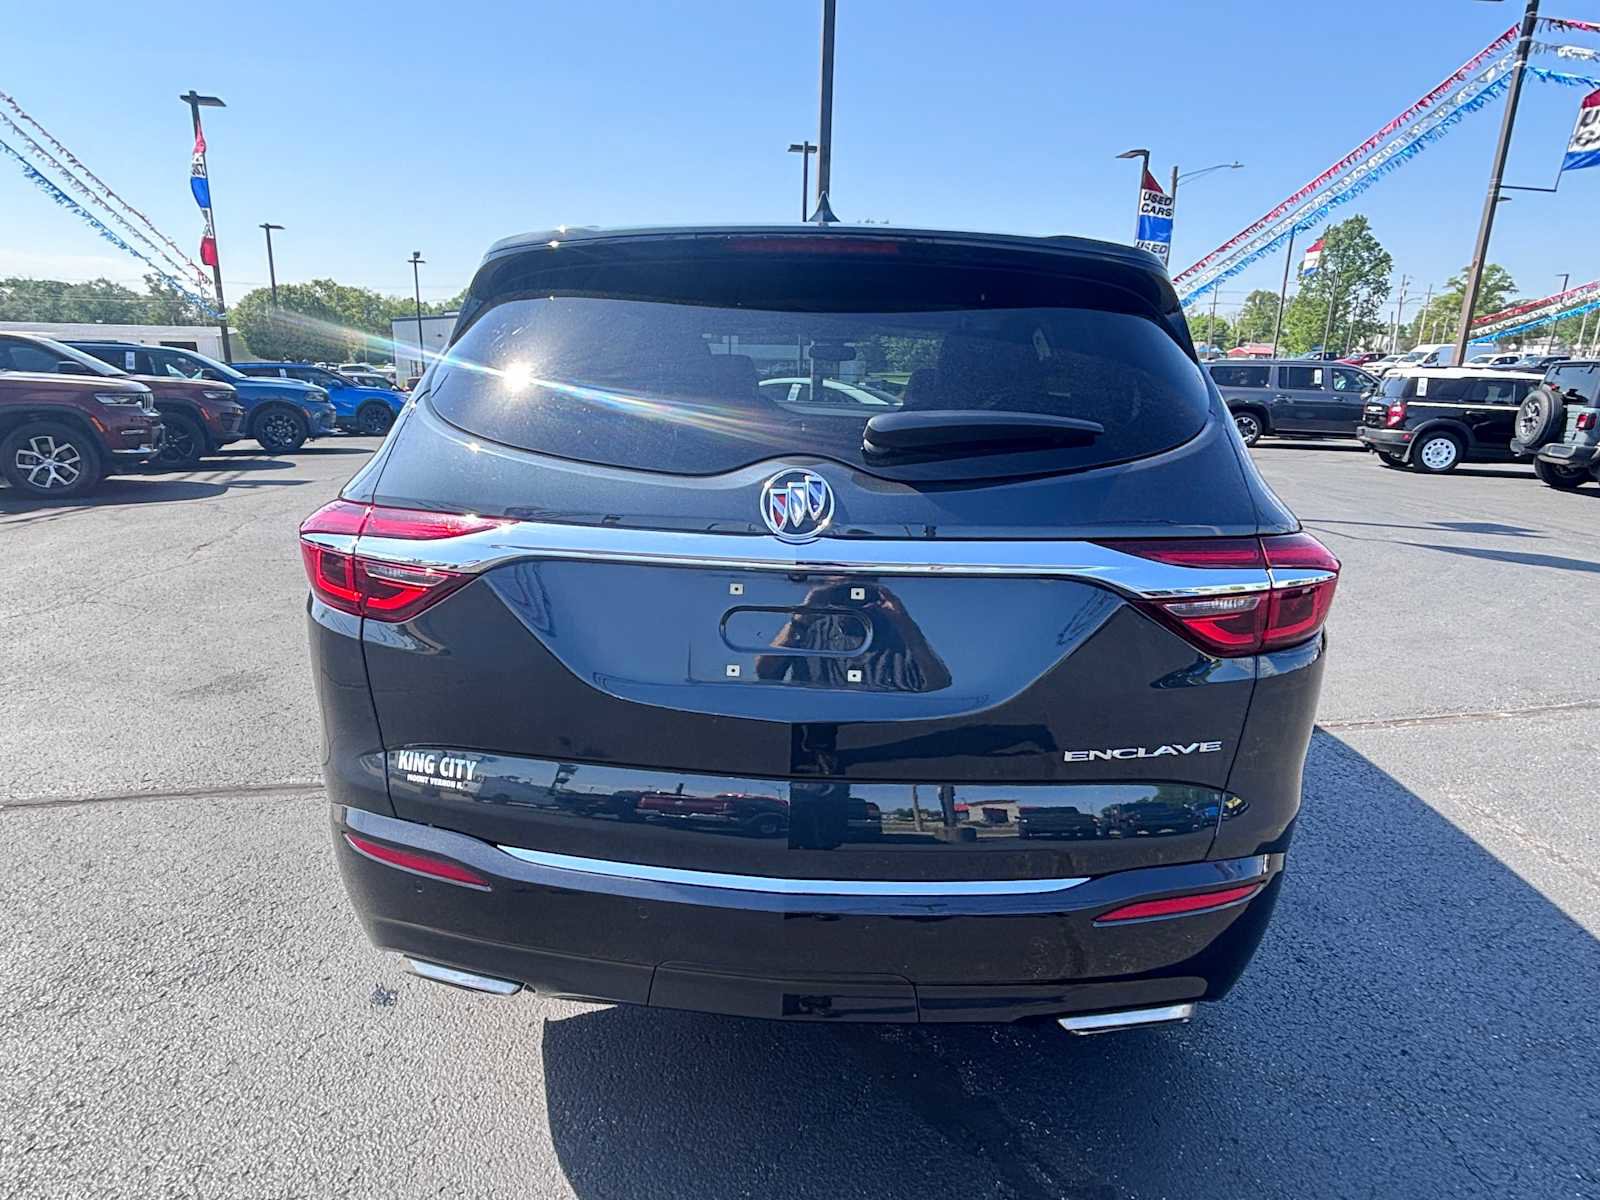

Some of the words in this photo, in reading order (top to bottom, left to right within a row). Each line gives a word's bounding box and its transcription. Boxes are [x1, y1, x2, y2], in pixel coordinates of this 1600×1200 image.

[1143, 192, 1172, 206] USED
[1141, 203, 1172, 216] CARS
[1063, 741, 1222, 762] ENCLAVE
[398, 750, 435, 774] KING
[440, 757, 477, 780] CITY
